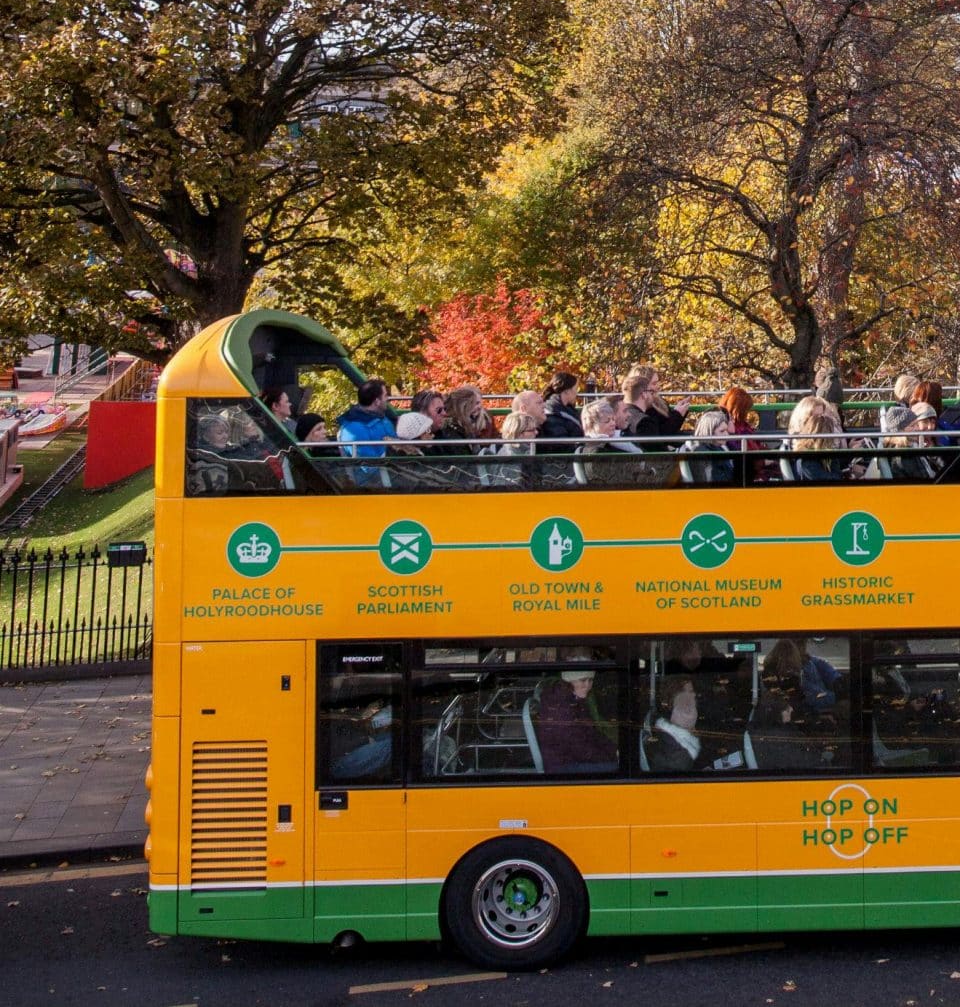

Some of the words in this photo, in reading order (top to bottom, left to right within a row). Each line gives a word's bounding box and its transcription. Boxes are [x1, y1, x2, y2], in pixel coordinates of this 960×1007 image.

[509, 583, 540, 595] OLD
[545, 582, 590, 594] TOWN
[594, 582, 604, 594] &
[635, 580, 710, 594] NATIONAL
[715, 578, 783, 591] MUSEUM
[822, 576, 894, 589] HISTORIC
[212, 588, 270, 600] PALACE
[275, 587, 295, 599] OF
[368, 584, 444, 598] SCOTTISH
[512, 599, 561, 612] ROYAL
[566, 598, 601, 610] MILE
[655, 597, 676, 609] OF
[681, 595, 763, 609] SCOTLAND
[801, 592, 916, 607] GRASSMARKET
[184, 603, 324, 618] HOLYROODHOUSE
[357, 601, 454, 614] PARLIAMENT
[801, 799, 854, 817] HOP
[863, 798, 899, 815] ON
[801, 828, 854, 846] HOP
[862, 826, 910, 845] OFF
